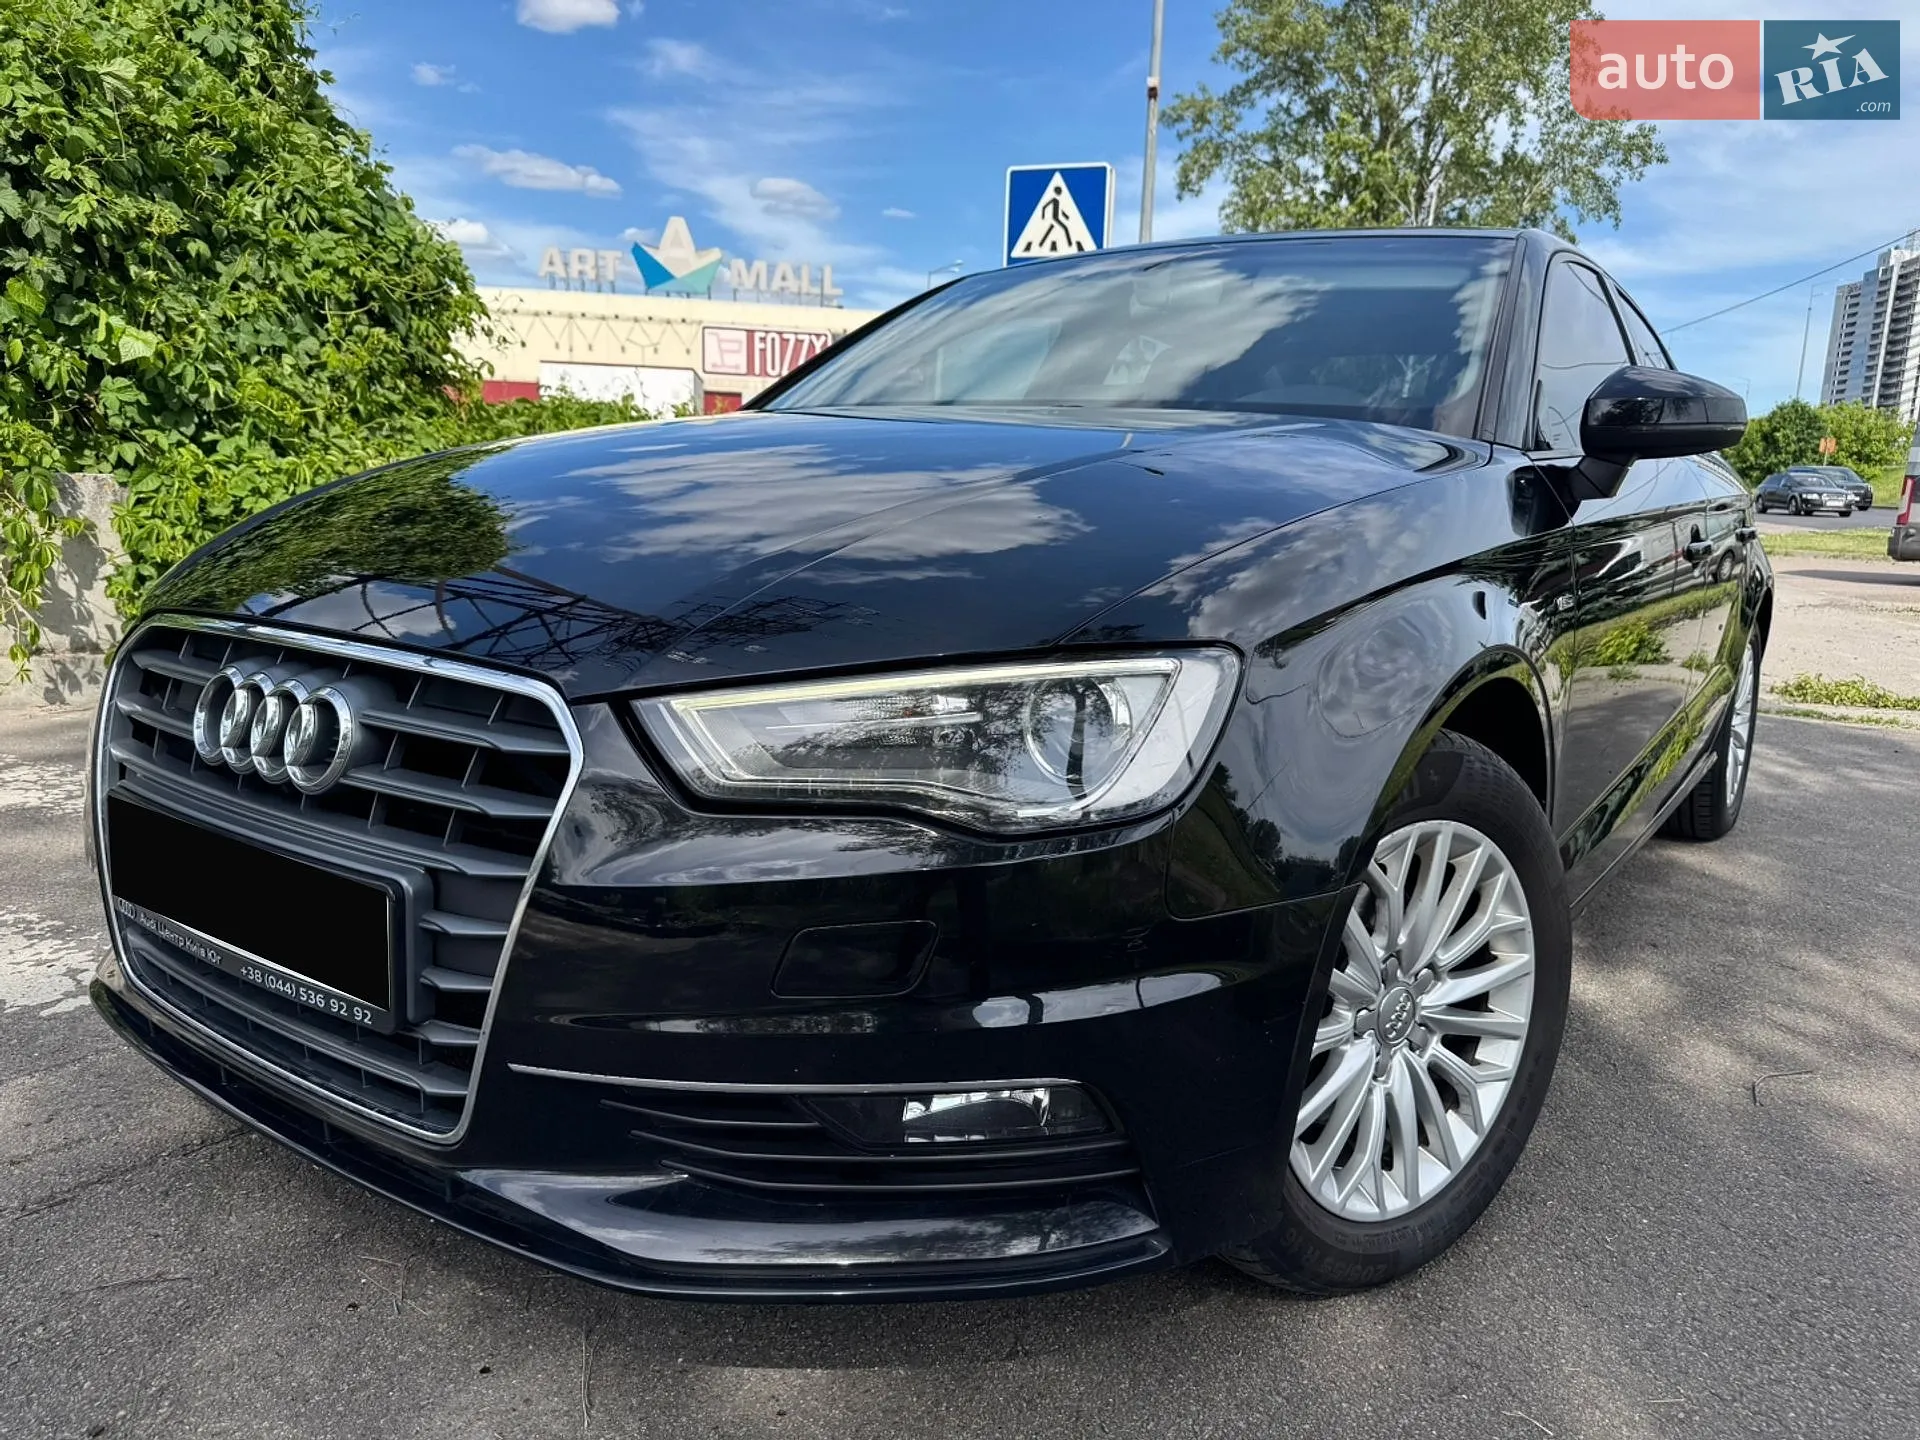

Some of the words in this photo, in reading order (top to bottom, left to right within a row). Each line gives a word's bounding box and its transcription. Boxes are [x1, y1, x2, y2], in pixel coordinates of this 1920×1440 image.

[538, 247, 622, 281] ART
[730, 258, 843, 296] MALL
[240, 966, 263, 983] +38
[265, 973, 296, 997] (044)
[299, 987, 325, 1008] 536
[329, 998, 348, 1016] 92
[353, 1006, 372, 1025] 92
